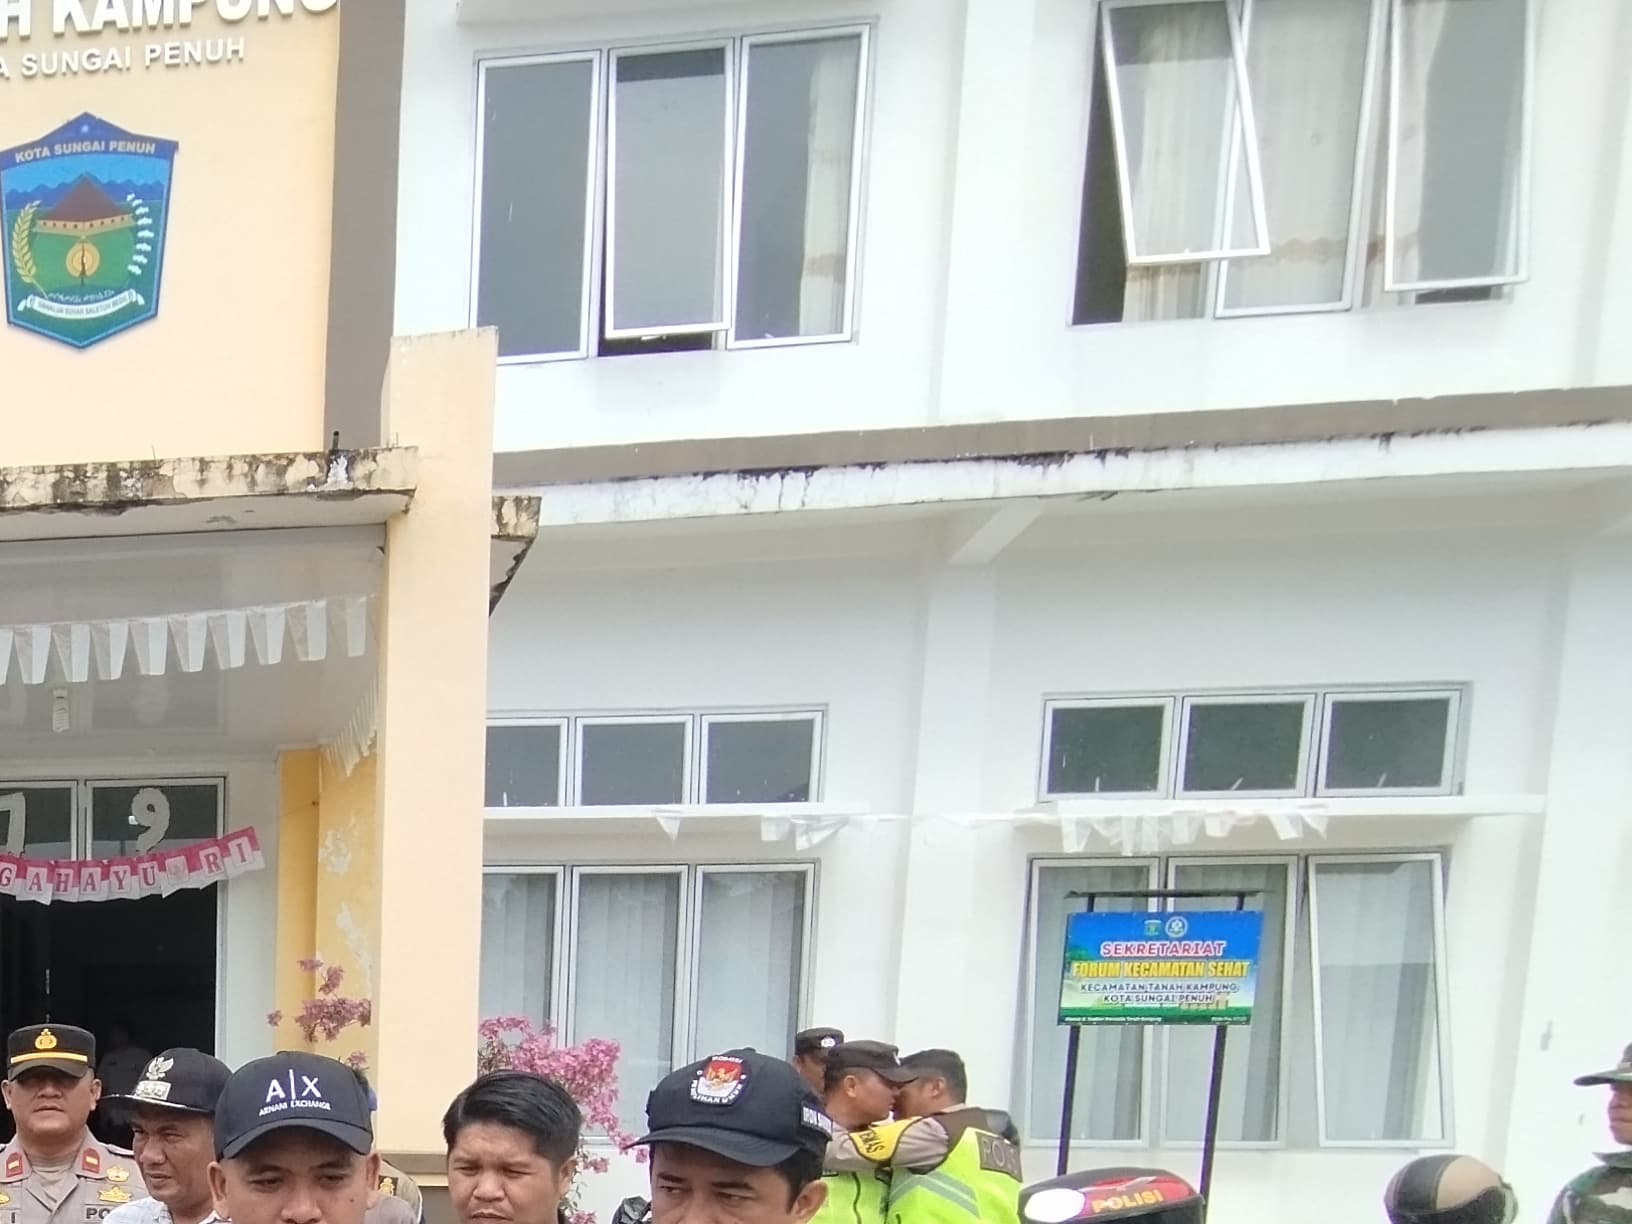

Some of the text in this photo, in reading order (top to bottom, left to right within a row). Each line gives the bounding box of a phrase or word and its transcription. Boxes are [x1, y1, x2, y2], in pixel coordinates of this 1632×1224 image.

[53, 0, 338, 35] KAMP
[20, 47, 131, 77] SUNGAI
[144, 37, 245, 68] PENUH
[14, 140, 156, 164] KOTA SUNGAI PENUH
[198, 839, 249, 875] RI
[1101, 941, 1226, 957] SEKRETARIAT
[1072, 961, 1250, 978] FORUM KECAMATAN SEHAT
[1080, 983, 1144, 992] KECAMATAN
[1147, 983, 1183, 991] TANAH
[1104, 994, 1215, 1003] KOTA SUNGAI PENUH
[1092, 1189, 1164, 1214] POLISI
